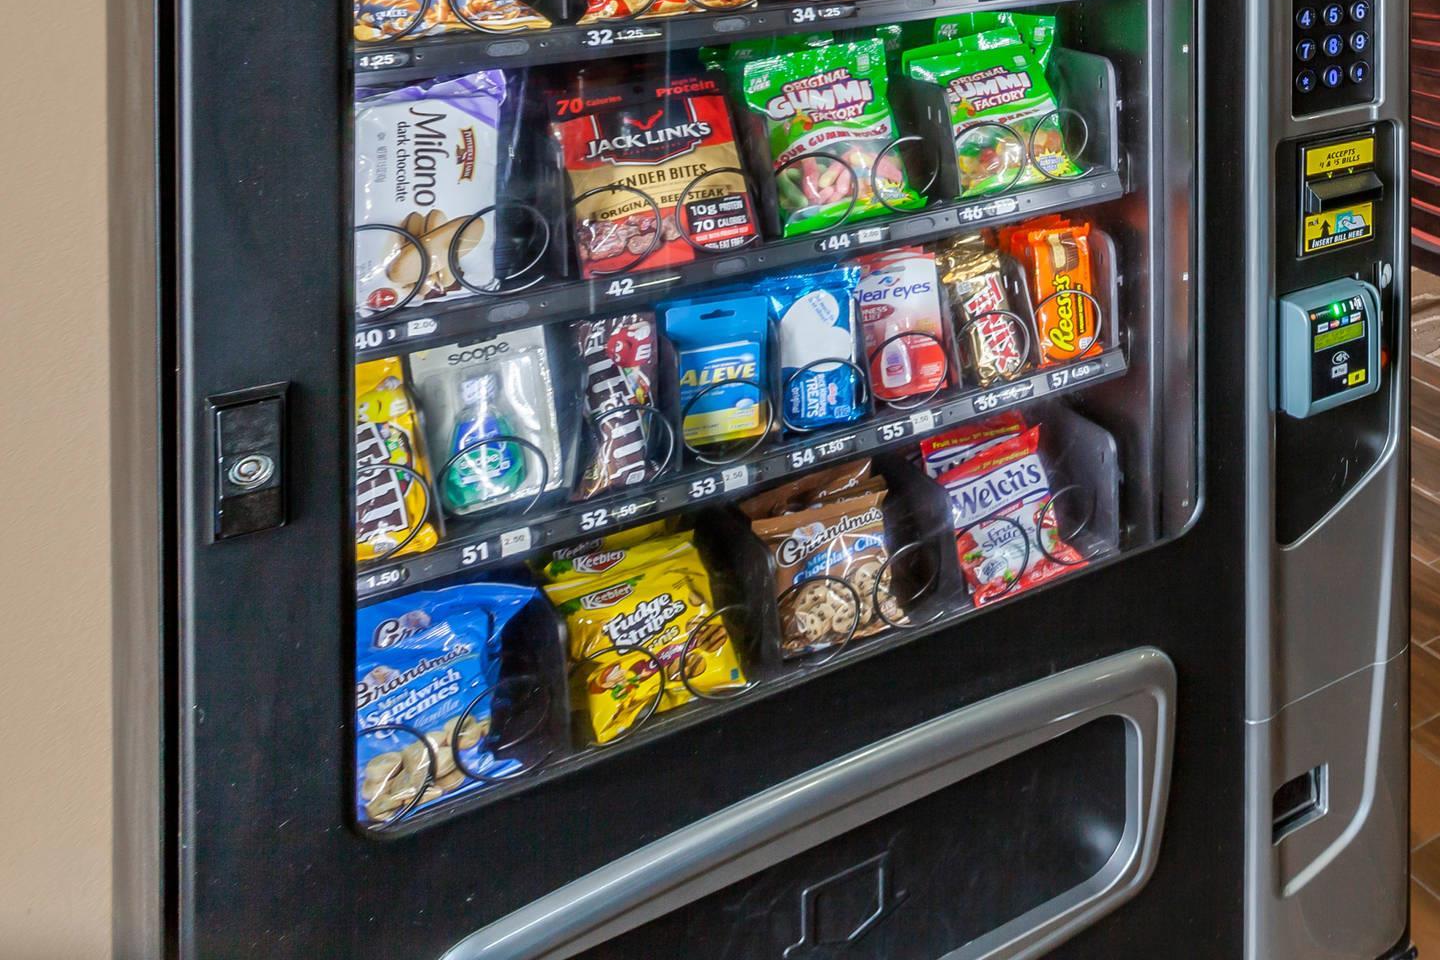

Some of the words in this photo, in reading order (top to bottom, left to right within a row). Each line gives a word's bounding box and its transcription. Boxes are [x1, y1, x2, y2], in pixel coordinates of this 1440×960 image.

[793, 8, 816, 22] 34
[1301, 11, 1310, 25] 4
[1329, 9, 1338, 23] 5
[1356, 4, 1364, 18] 6
[586, 29, 613, 45] 32
[1329, 39, 1338, 54] 8
[1356, 35, 1364, 50] 9
[1302, 43, 1310, 58] 7
[782, 68, 851, 93] ORIGINAL
[950, 67, 1008, 86] ORIGINAL
[1329, 70, 1337, 85] 0
[656, 80, 715, 97] Protein
[556, 99, 584, 116] 70
[768, 80, 872, 120] GUMMI
[973, 88, 1026, 111] FACTORY
[811, 102, 866, 123] FACTORY
[396, 122, 411, 146] dark
[588, 132, 645, 158] JACK
[645, 122, 712, 145] LINK'S
[409, 107, 449, 207] Milano
[1327, 148, 1355, 159] ACCEPTS
[1342, 155, 1361, 164] BILLS
[396, 149, 411, 202] chocolate
[671, 163, 708, 180] BITES
[689, 189, 724, 200] STEAK
[690, 204, 717, 217] 10g
[693, 219, 715, 233] 70
[1312, 236, 1333, 249] INSERT
[1334, 232, 1347, 243] BILL
[1348, 228, 1364, 239] HERE
[608, 279, 634, 296] 42
[856, 287, 890, 303] lear
[893, 282, 931, 299] eyes
[1049, 274, 1075, 352] Reese's
[355, 329, 383, 349] 40
[447, 342, 510, 366] scope
[680, 362, 757, 387] ALEVE
[1052, 371, 1069, 386] 57
[806, 378, 818, 418] TREATS
[882, 424, 905, 440] 55
[791, 451, 815, 468] 54
[690, 478, 717, 498] 53
[951, 464, 1042, 518] Welch's
[581, 508, 608, 530] 52
[777, 507, 884, 567] Grandma's
[462, 541, 489, 565] 51
[574, 551, 624, 572] Keebler
[366, 571, 400, 588] 1.50
[581, 584, 633, 607] Keebler
[605, 594, 672, 639] Fudge
